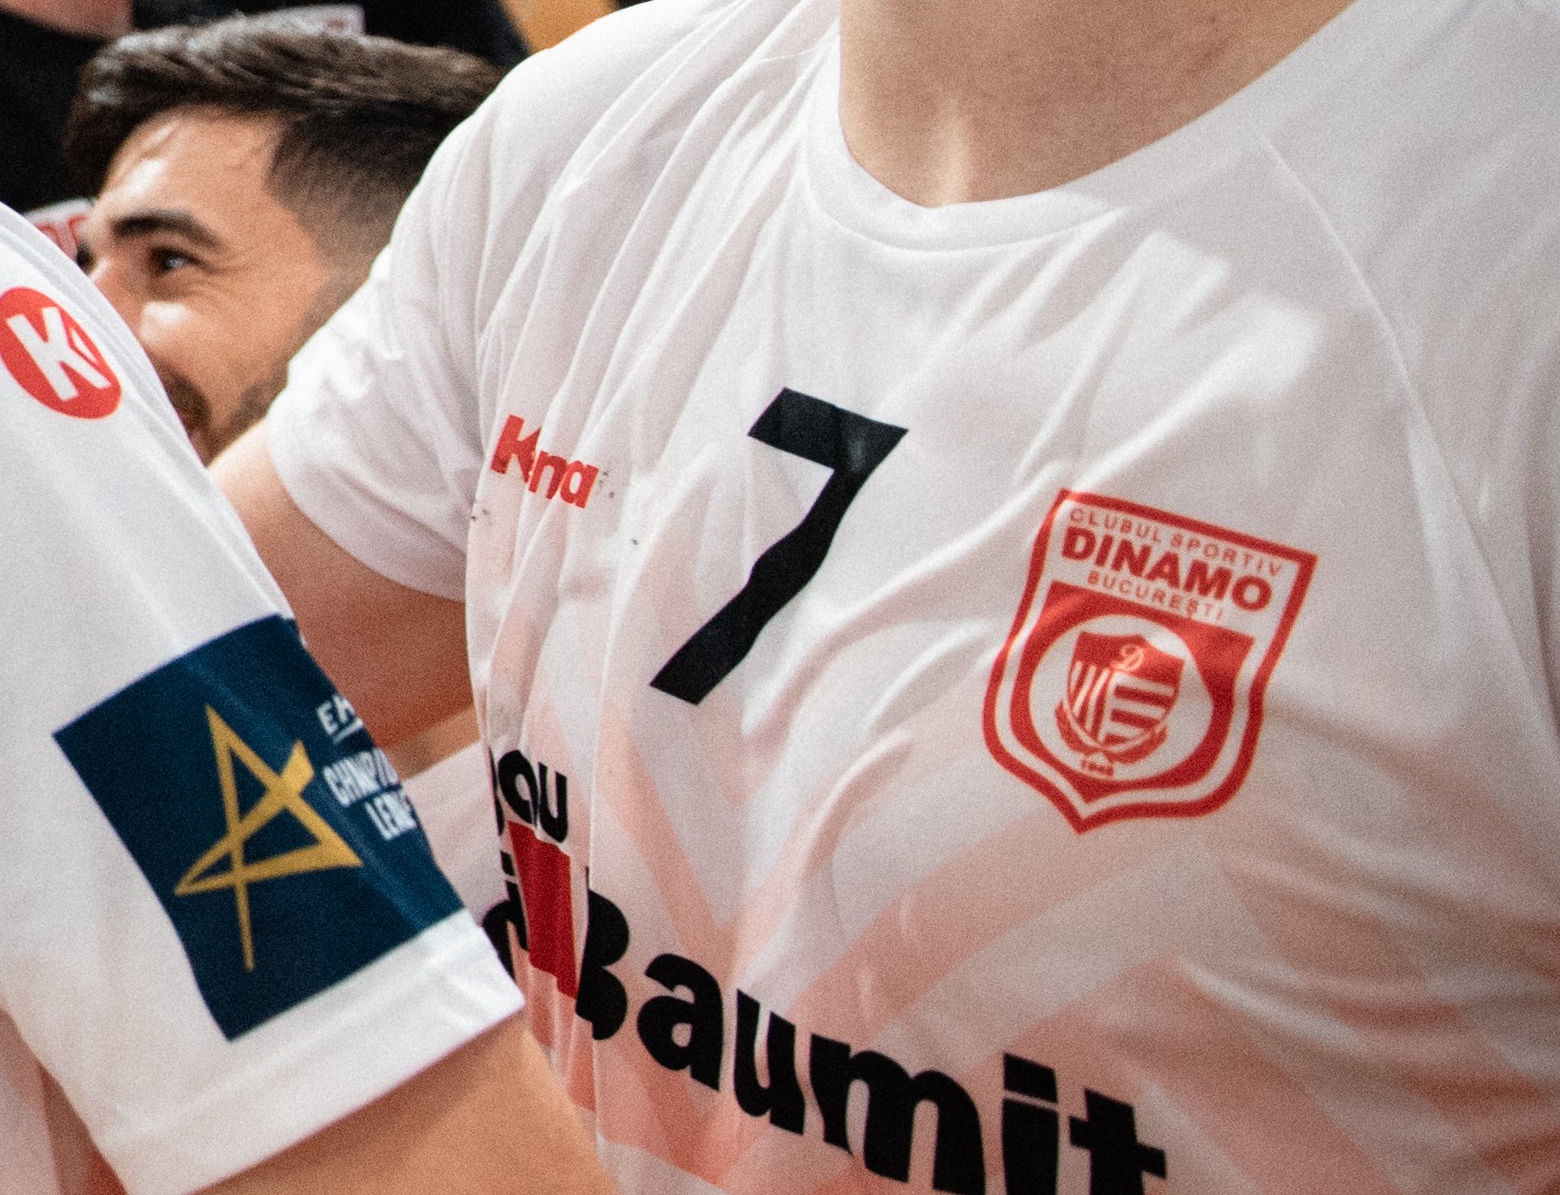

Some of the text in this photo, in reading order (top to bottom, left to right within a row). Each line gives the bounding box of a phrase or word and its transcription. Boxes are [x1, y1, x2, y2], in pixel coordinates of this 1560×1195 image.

[649, 387, 910, 706] 7
[1061, 526, 1273, 612] DINAMO
[1070, 507, 1283, 577] CLUBUL SPORTIV
[574, 868, 1168, 1195] Baumit
